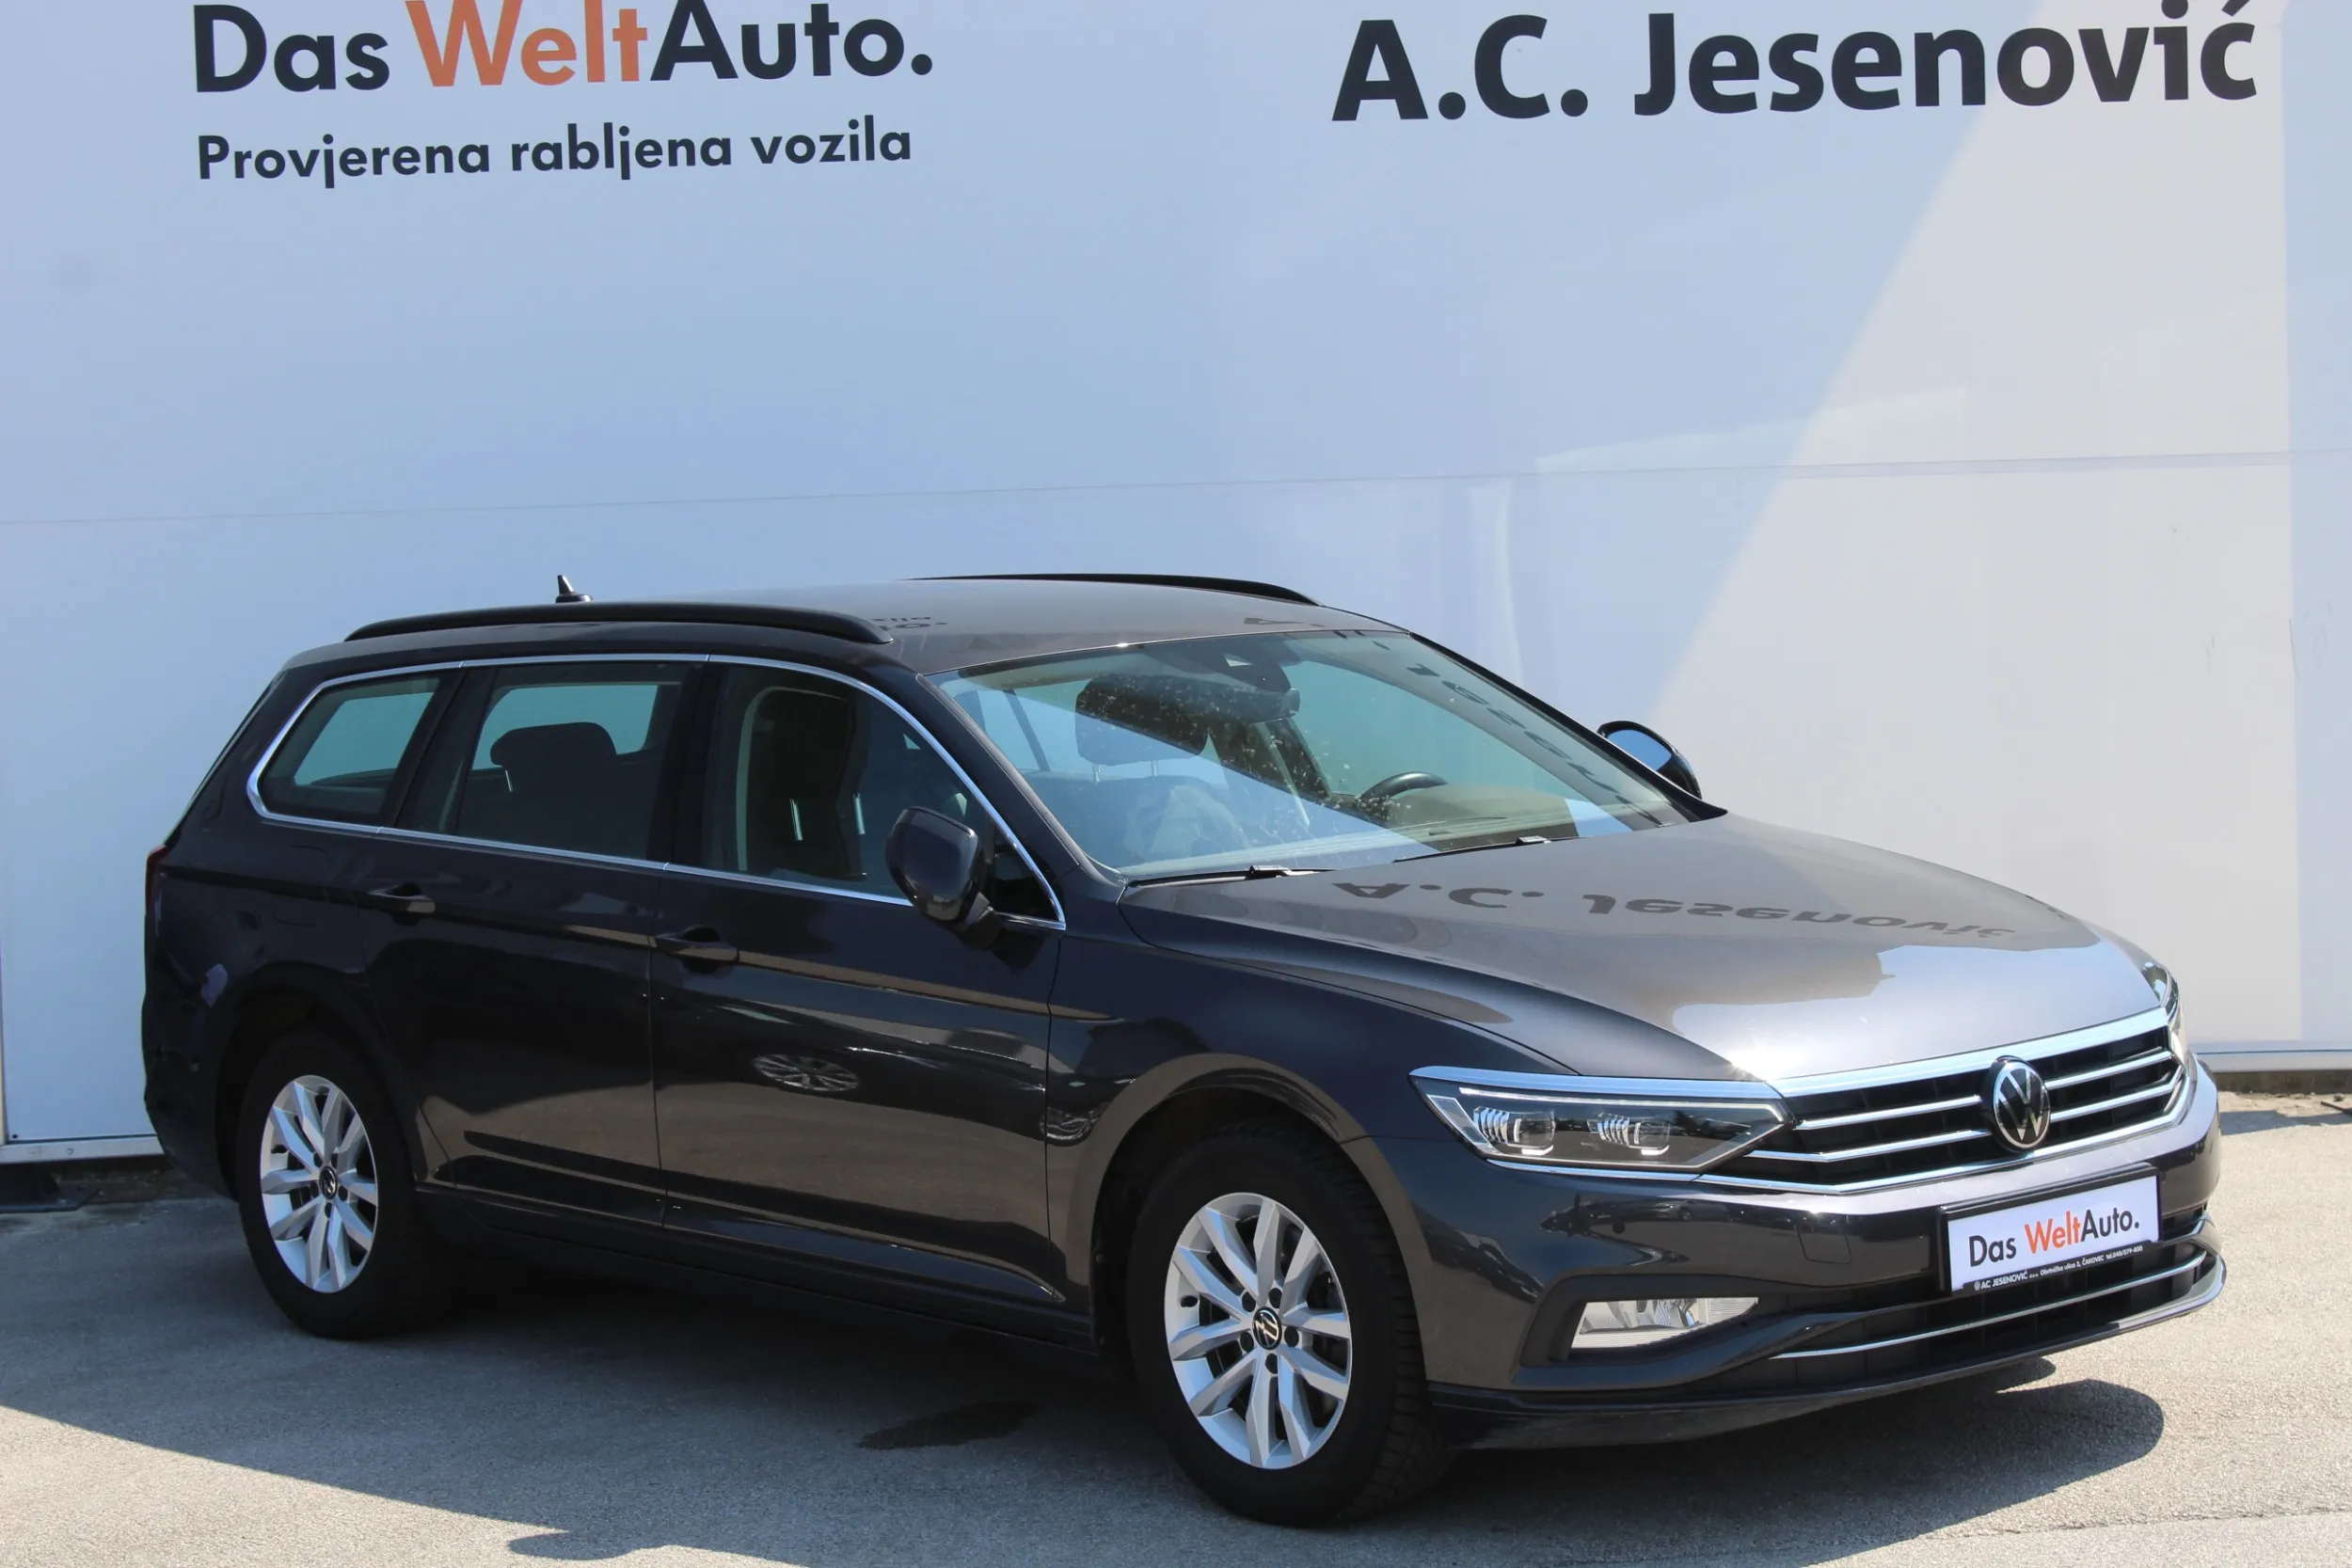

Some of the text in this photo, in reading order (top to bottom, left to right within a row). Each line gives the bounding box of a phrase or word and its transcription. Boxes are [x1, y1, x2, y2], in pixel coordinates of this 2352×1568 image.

[192, 0, 933, 92] Das WeltAuto.
[1332, 0, 2258, 121] A.C. Jesenović
[197, 115, 913, 189] Provjerena rabljena vozila
[1969, 1207, 2139, 1267] Das WeltAuto.
[1980, 1280, 1991, 1290] AC
[1992, 1270, 2028, 1288] JESENOVIĆ
[2082, 1254, 2105, 1266] ČAKOVEC
